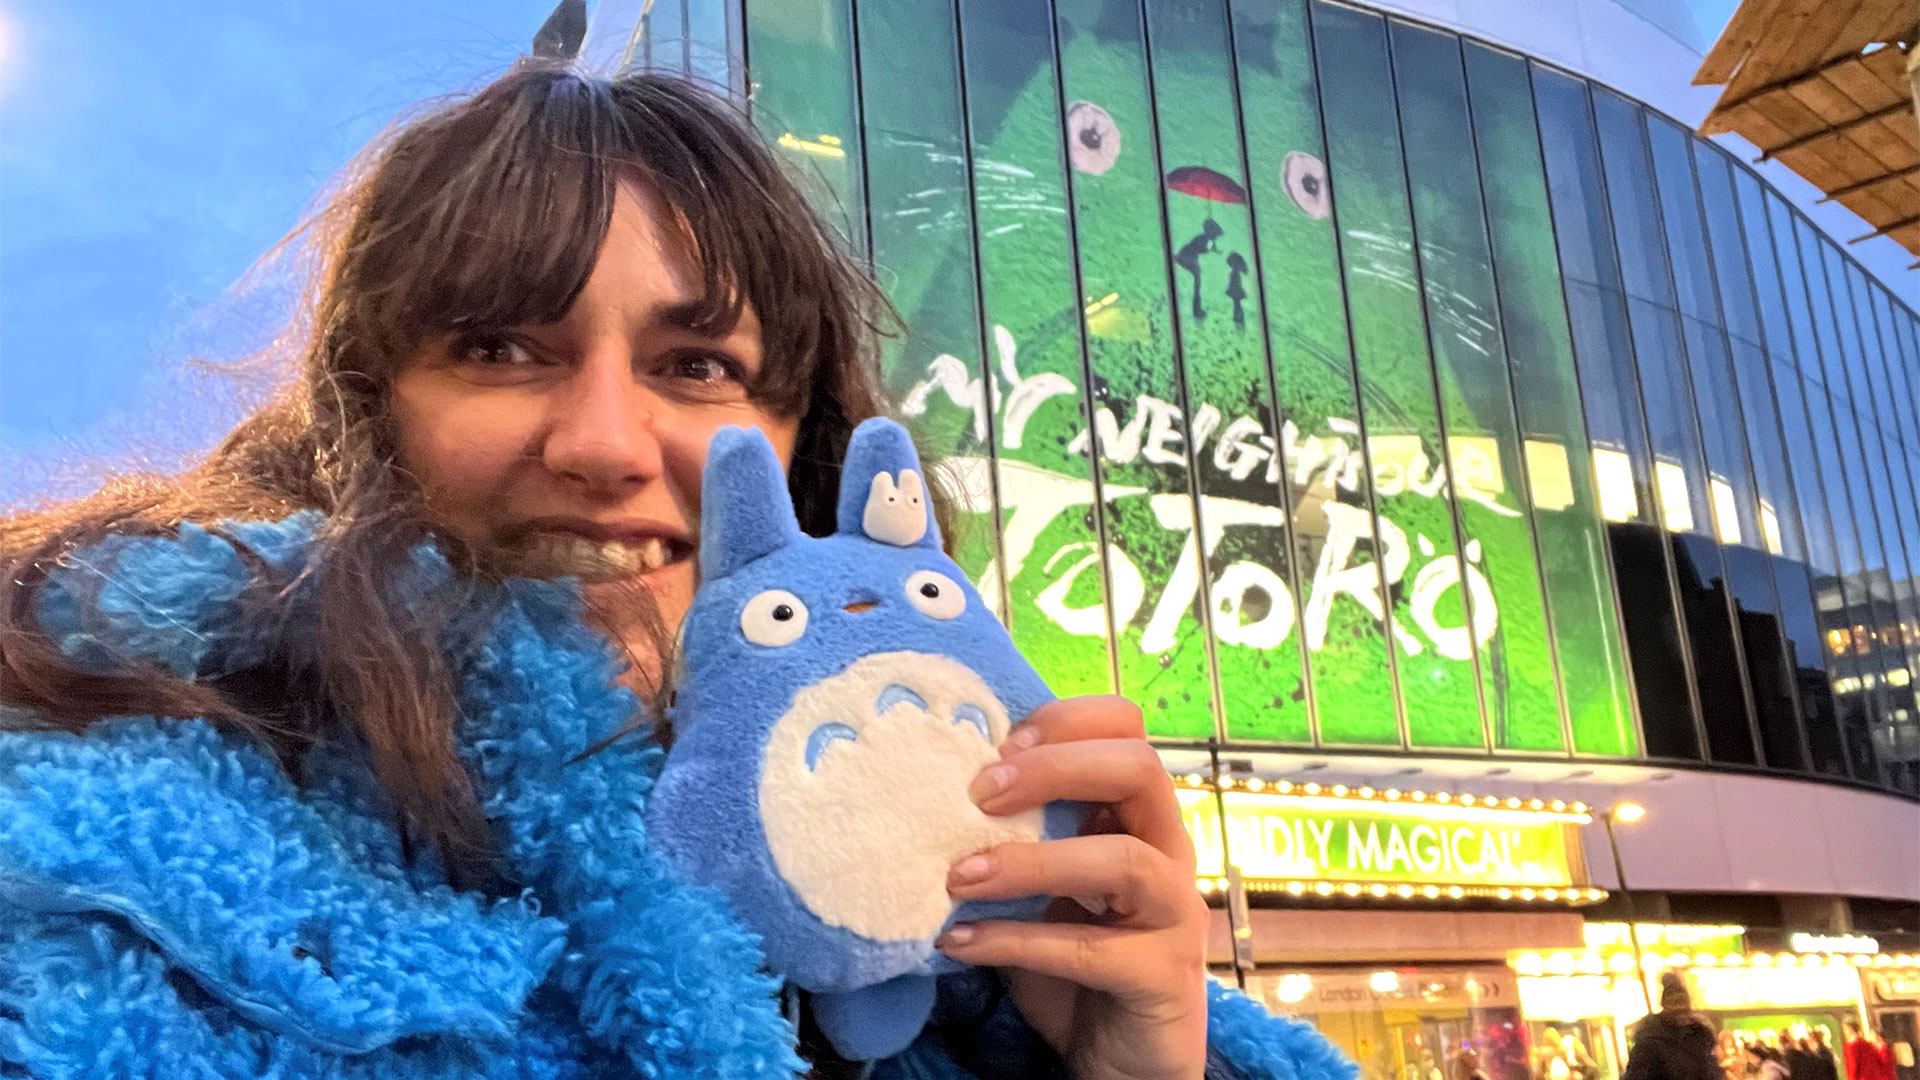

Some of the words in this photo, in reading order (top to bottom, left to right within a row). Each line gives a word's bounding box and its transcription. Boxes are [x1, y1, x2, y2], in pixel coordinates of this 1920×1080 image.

[902, 325, 1077, 449] MY
[933, 455, 1499, 660] TOTORO
[1184, 811, 1333, 869] UNDLY
